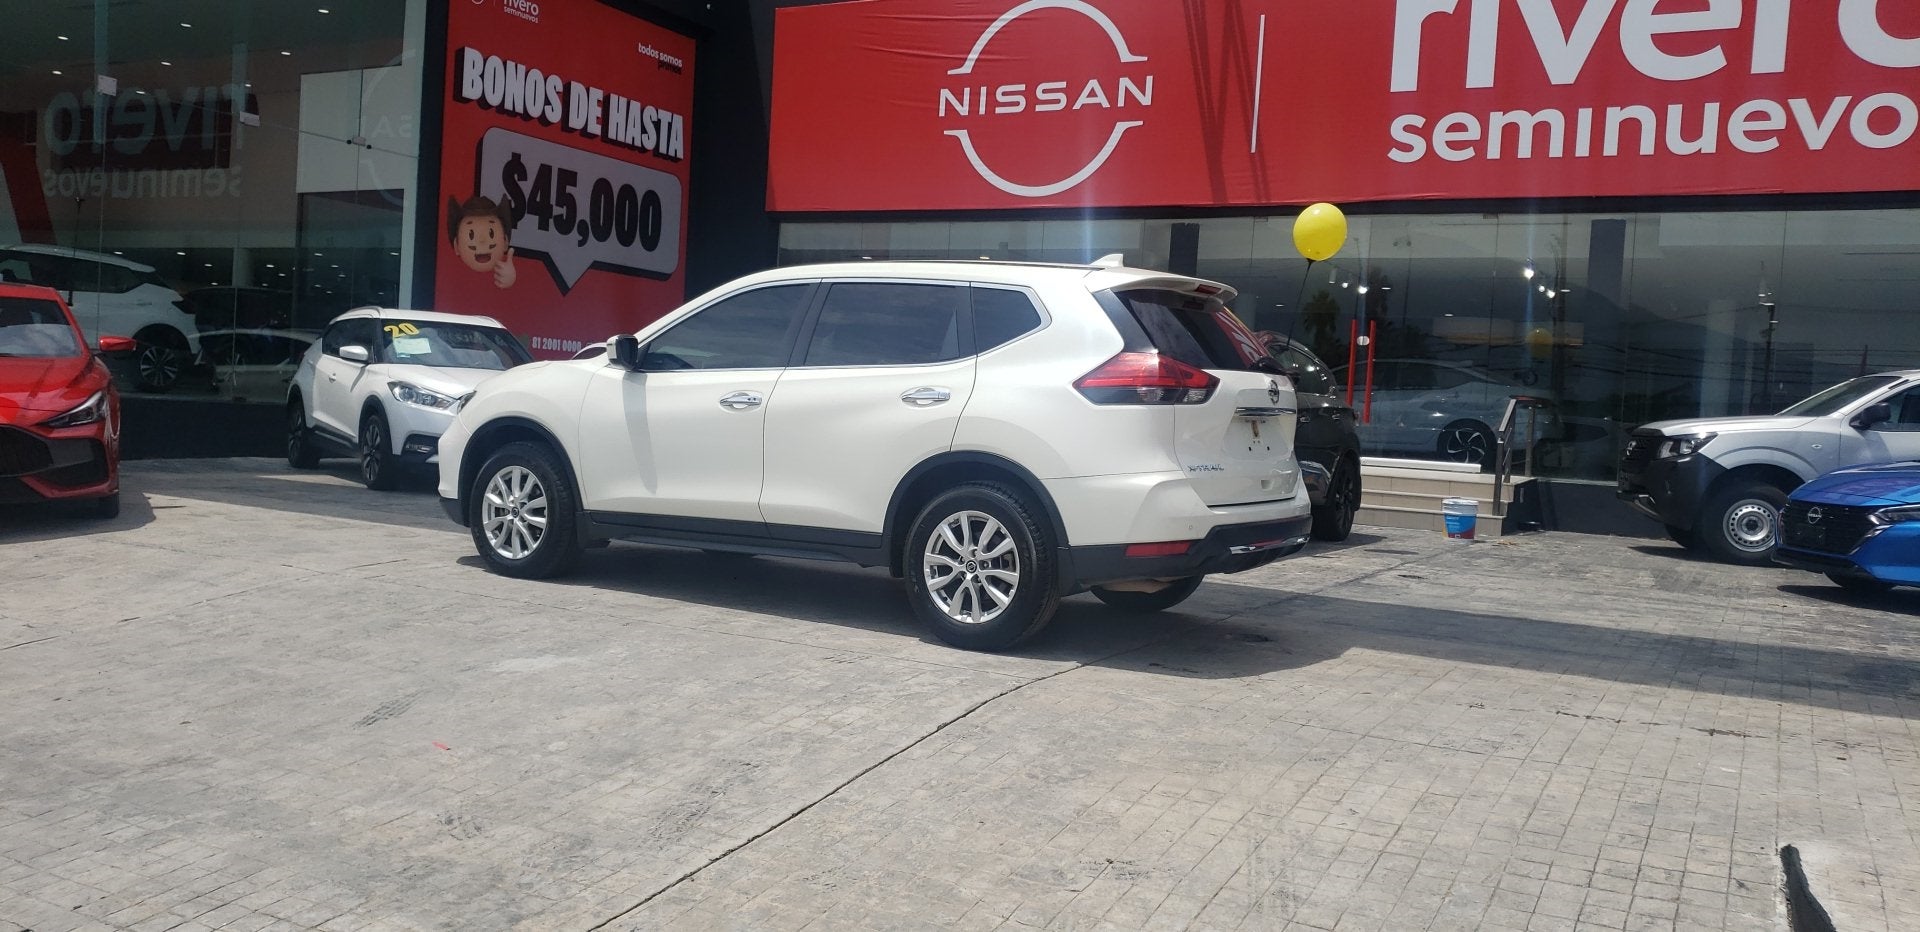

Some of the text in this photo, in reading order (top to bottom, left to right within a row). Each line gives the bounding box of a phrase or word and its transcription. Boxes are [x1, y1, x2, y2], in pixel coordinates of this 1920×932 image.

[503, 6, 539, 24] seminuevos
[638, 42, 683, 68] todos somos
[462, 46, 684, 160] BONOS DE HASTA
[938, 75, 1154, 118] NISSAN
[502, 152, 662, 252] $45,000
